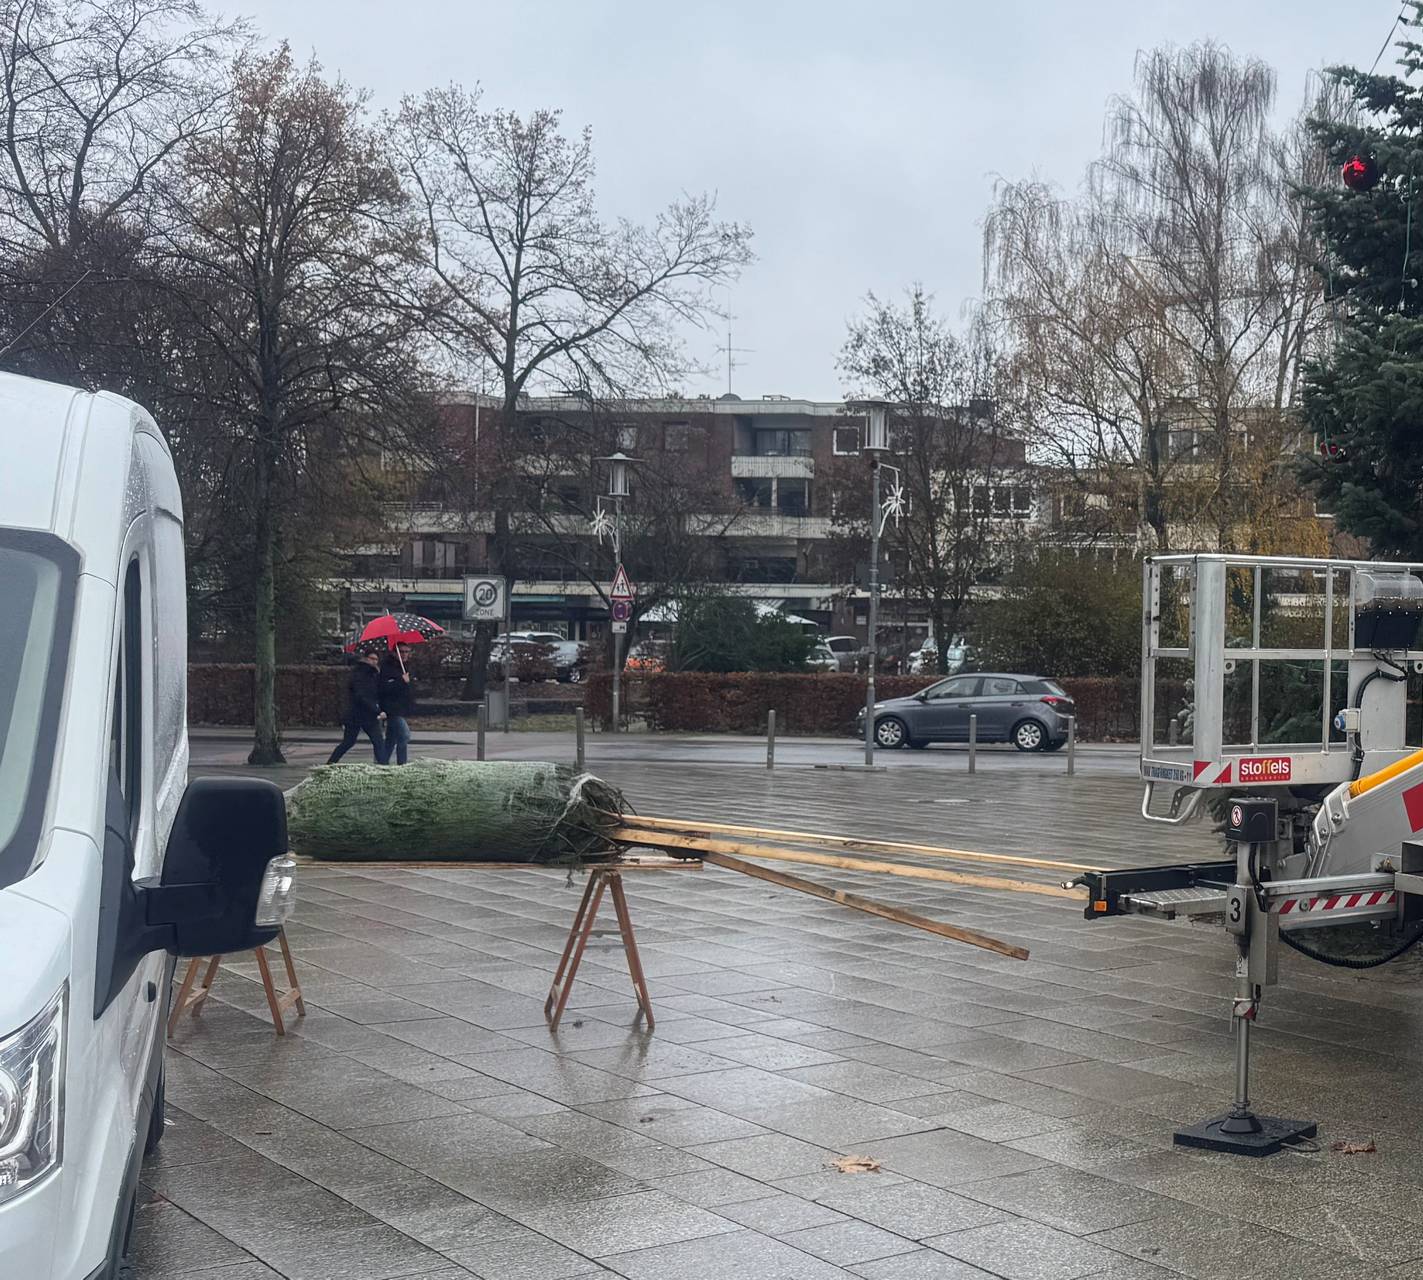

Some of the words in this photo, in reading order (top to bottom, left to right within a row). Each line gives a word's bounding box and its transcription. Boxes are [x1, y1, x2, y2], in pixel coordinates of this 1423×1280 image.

[479, 588, 492, 600] 20
[1241, 759, 1290, 775] stoffels
[1230, 897, 1241, 923] 3
